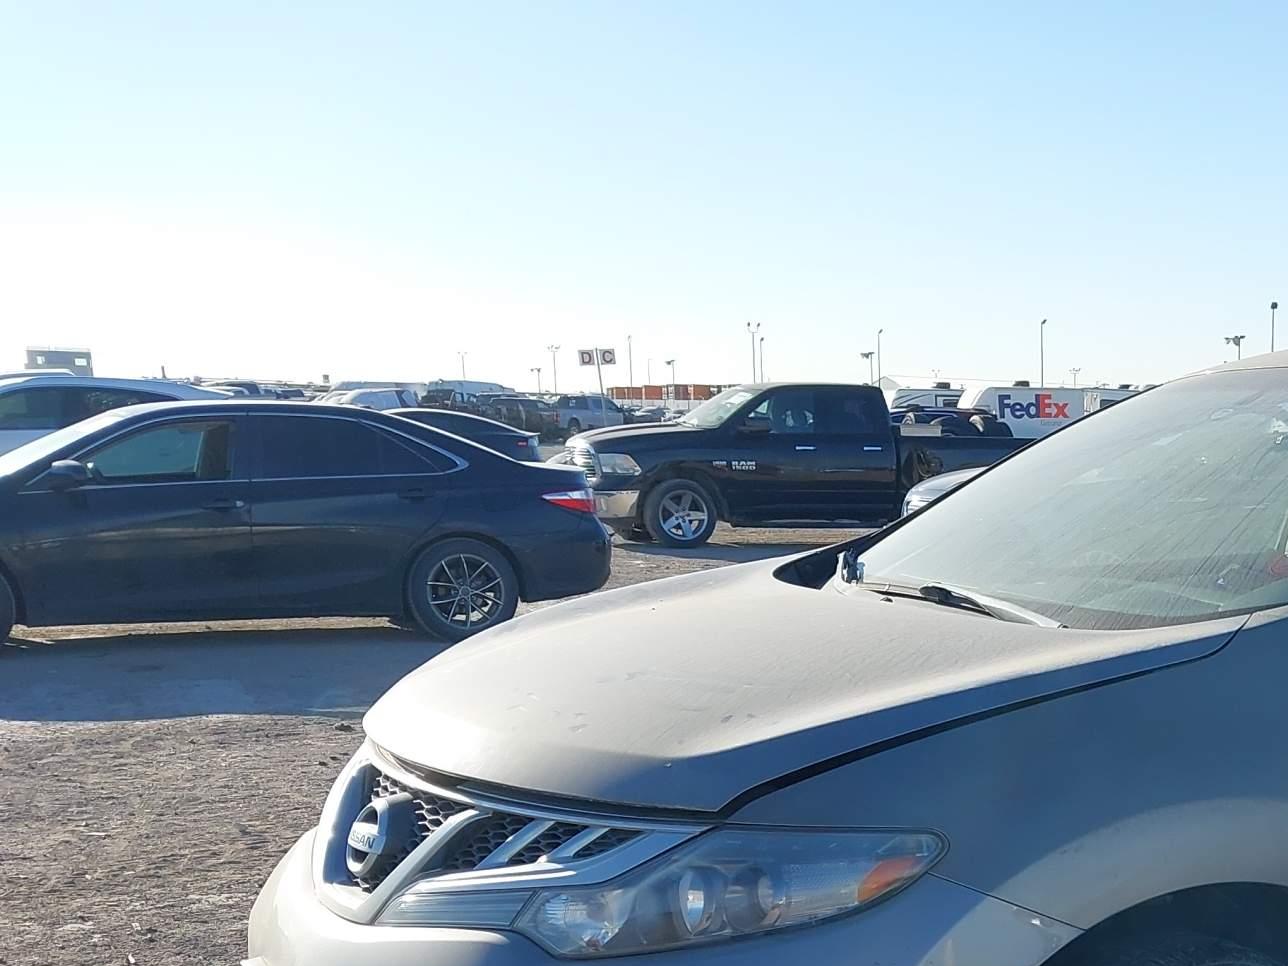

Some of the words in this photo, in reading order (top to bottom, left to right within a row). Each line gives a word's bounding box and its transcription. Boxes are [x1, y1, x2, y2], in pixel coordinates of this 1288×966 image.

[580, 351, 592, 364] D
[602, 350, 613, 363] C
[998, 393, 1069, 419] FedEx
